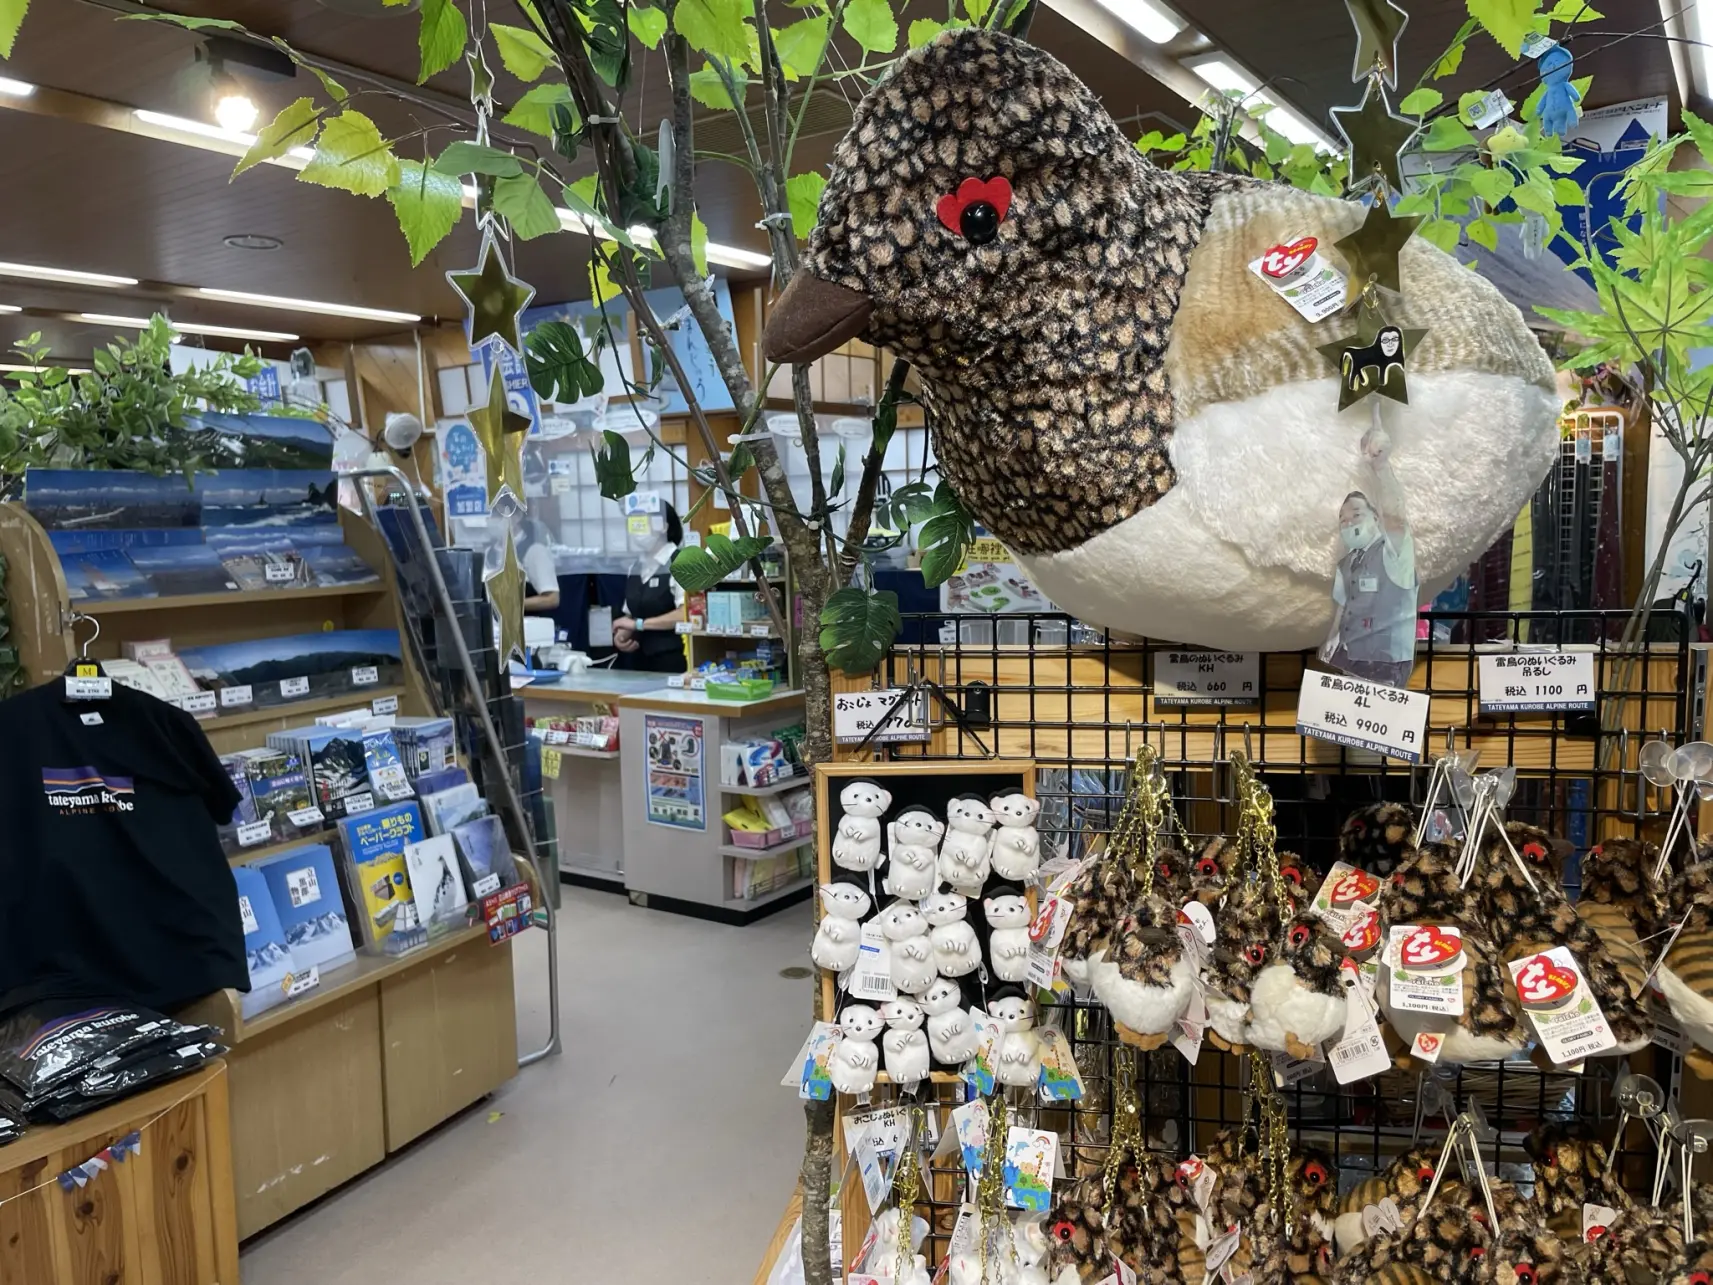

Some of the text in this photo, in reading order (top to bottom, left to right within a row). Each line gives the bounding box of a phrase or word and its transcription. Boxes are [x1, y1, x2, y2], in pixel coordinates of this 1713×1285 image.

[1264, 252, 1304, 275] ty
[1169, 653, 1244, 664] 雷鳥のぬいぐるみ
[1495, 655, 1577, 667] 雷鳥のぬいぐるみ
[82, 667, 92, 677] M
[1198, 664, 1214, 673] KH
[1522, 667, 1552, 677] 吊るし
[1176, 681, 1253, 691] 税込 660 円
[1320, 675, 1410, 705] 雷鳥のぬいぐるみ
[1505, 684, 1588, 696] 税込 1100 円
[836, 697, 872, 711] おこじょ
[1353, 695, 1371, 709] 4L
[856, 720, 874, 730] 税込
[1324, 711, 1348, 728] 税込
[1356, 718, 1388, 736] 9900
[1401, 730, 1415, 743] 円
[1303, 726, 1413, 761] TATEYAMA KUROBE ALPINE ROUTE
[48, 795, 100, 809] tateyama
[101, 791, 134, 811] kube
[299, 877, 309, 896] 黒部
[307, 866, 317, 888] 立山
[1335, 874, 1361, 901] ty
[240, 898, 253, 919] 立山
[1344, 916, 1373, 948] ty
[1406, 931, 1441, 963] ty
[1521, 963, 1557, 999] ty
[32, 1012, 140, 1061] tateyama kurobe
[884, 1119, 896, 1128] KH
